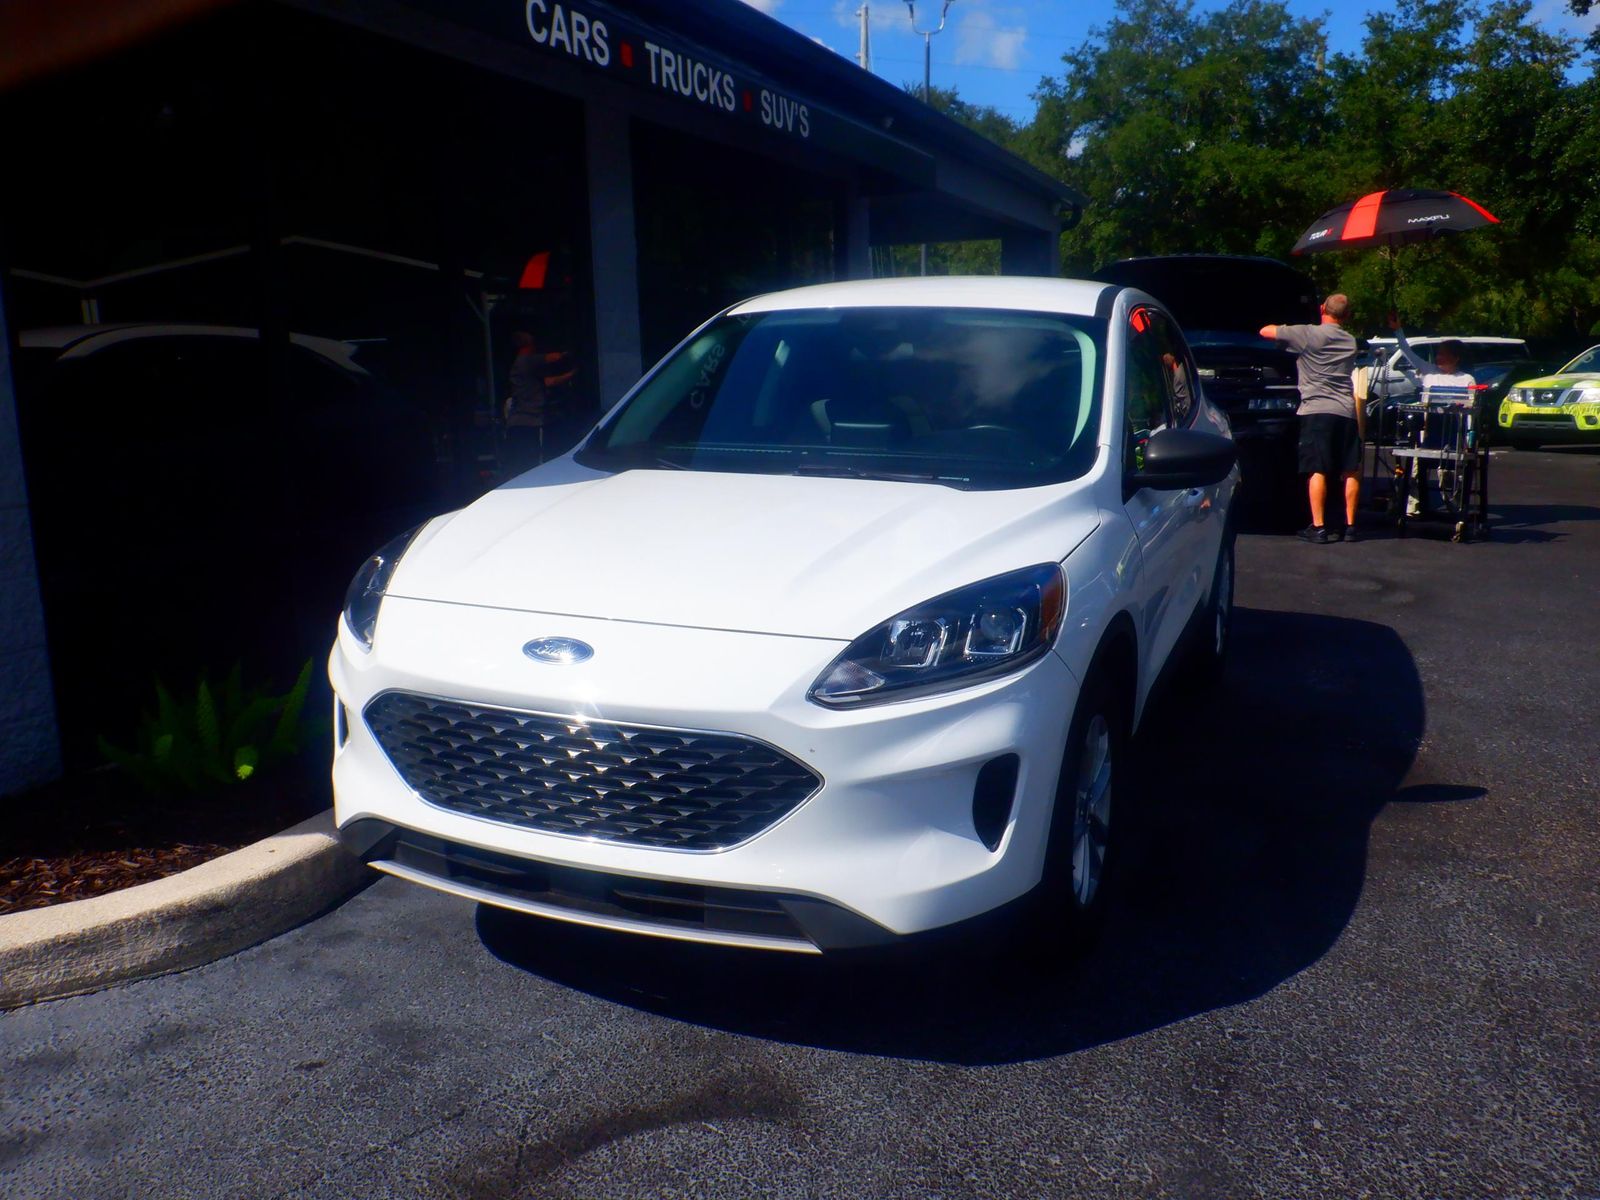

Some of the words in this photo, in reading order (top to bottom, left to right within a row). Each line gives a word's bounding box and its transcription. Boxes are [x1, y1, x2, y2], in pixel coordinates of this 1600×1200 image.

[525, 0, 610, 67] CARS
[644, 41, 736, 112] TRUCKS
[760, 89, 810, 138] SUV'S
